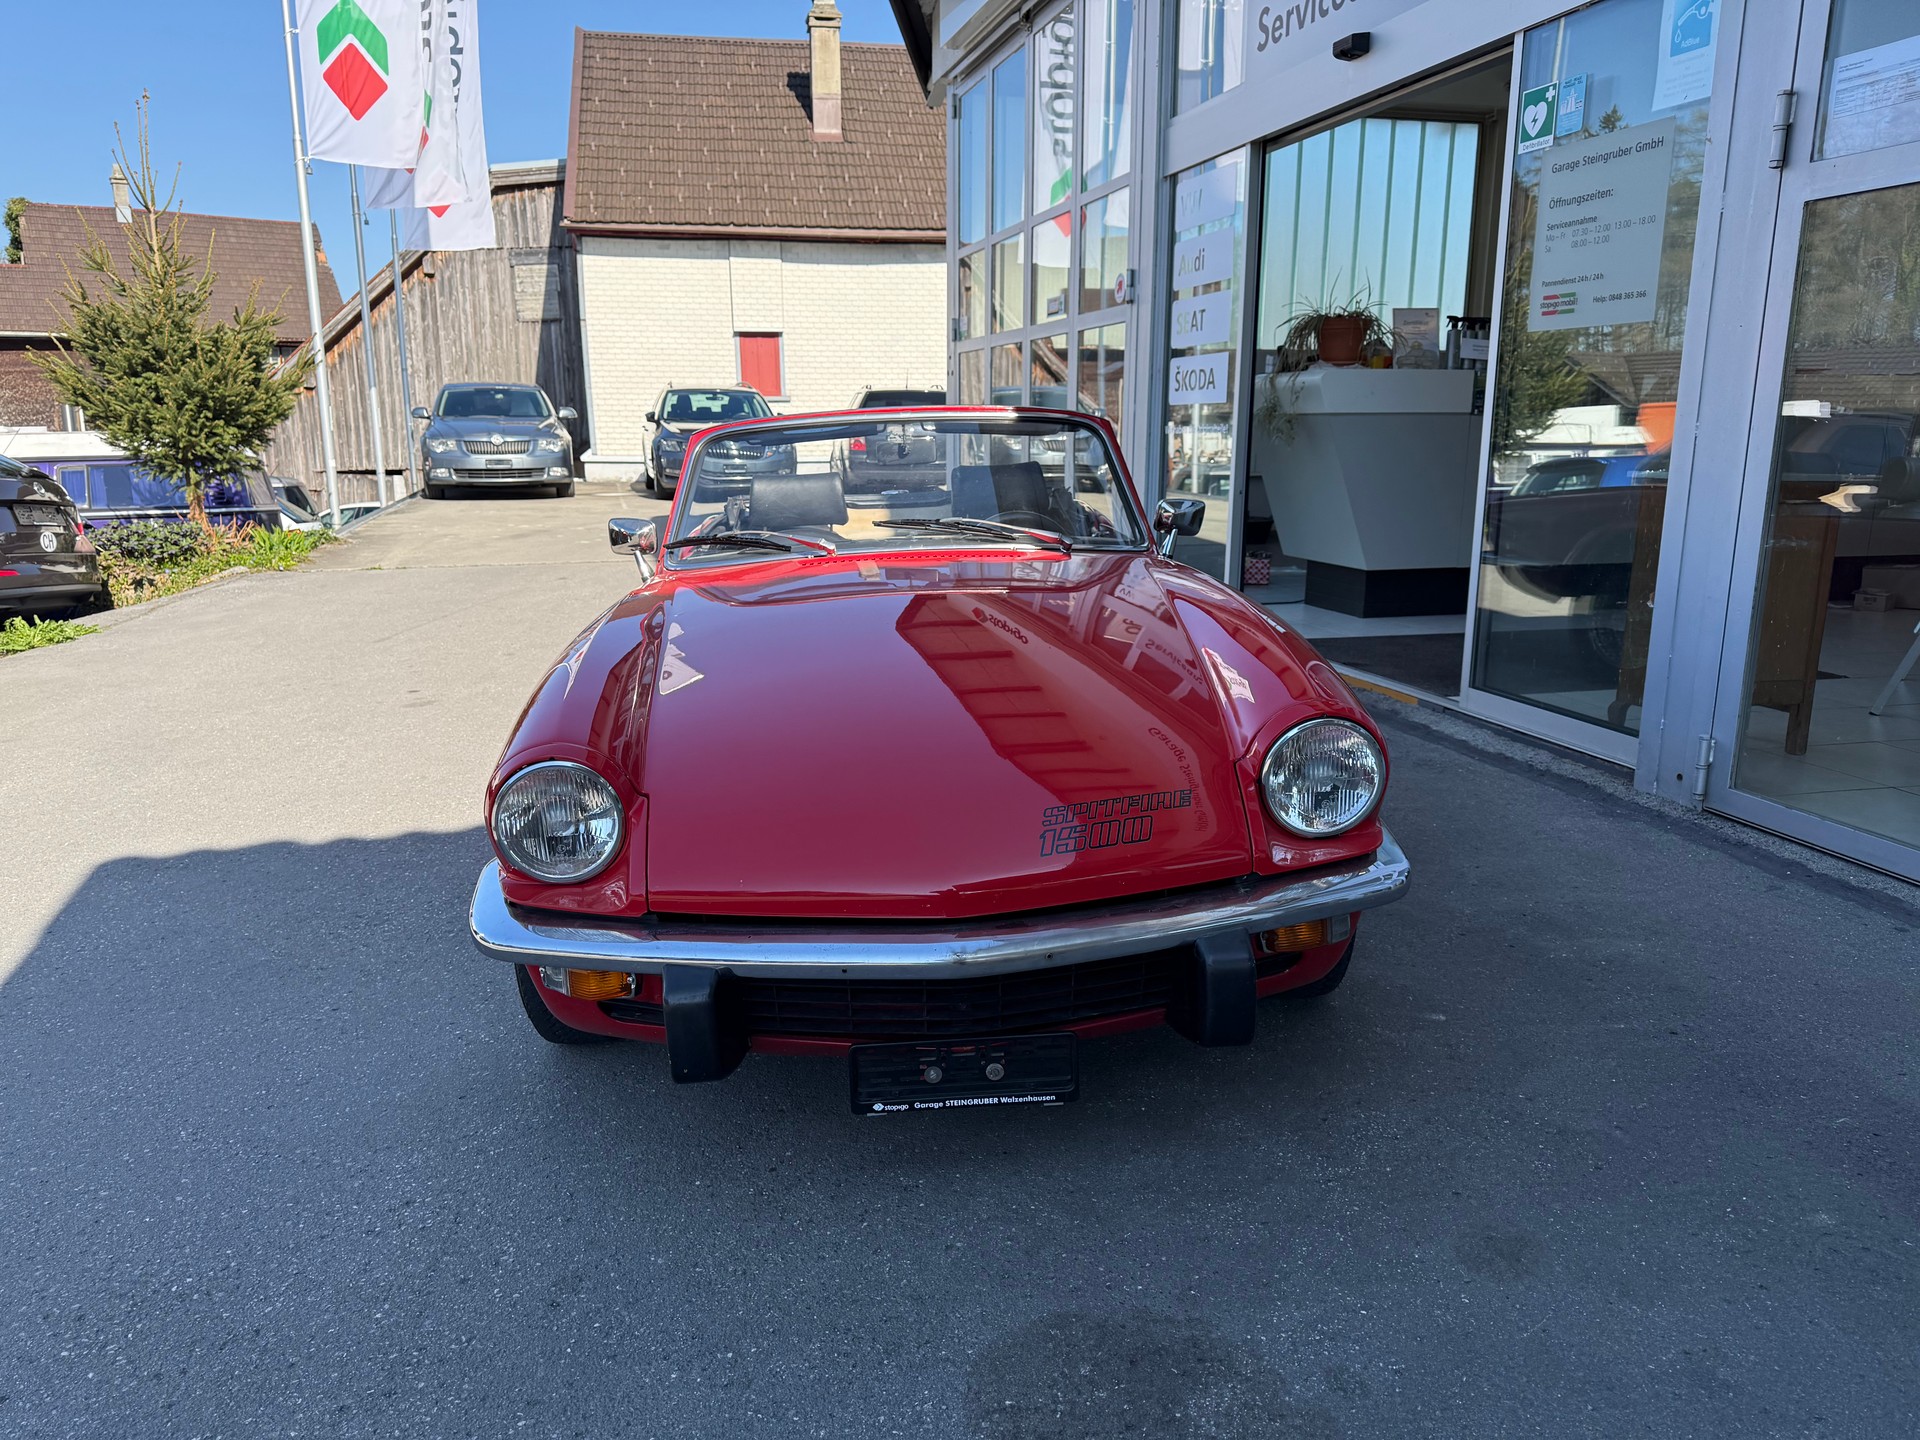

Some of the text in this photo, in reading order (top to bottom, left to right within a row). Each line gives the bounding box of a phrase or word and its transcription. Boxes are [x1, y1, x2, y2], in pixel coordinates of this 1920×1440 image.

[1522, 138, 1551, 151] Defibrillator
[1551, 136, 1664, 173] Garage Steingruber GmbH
[1548, 187, 1614, 209] Öffnungszeiten:
[1546, 215, 1598, 232] Serviceannahme
[1178, 248, 1205, 277] Audi
[1541, 277, 1577, 288] Pannendienst
[1176, 309, 1206, 335] SEAT
[1174, 365, 1216, 392] ŠKODA
[42, 534, 55, 549] CH
[1042, 789, 1192, 826] SPITFIRE
[1039, 815, 1153, 857] 1500
[914, 1101, 944, 1110] Garage
[945, 1097, 999, 1107] STEINGRUBER
[1000, 1094, 1056, 1103] Walzenhausen
